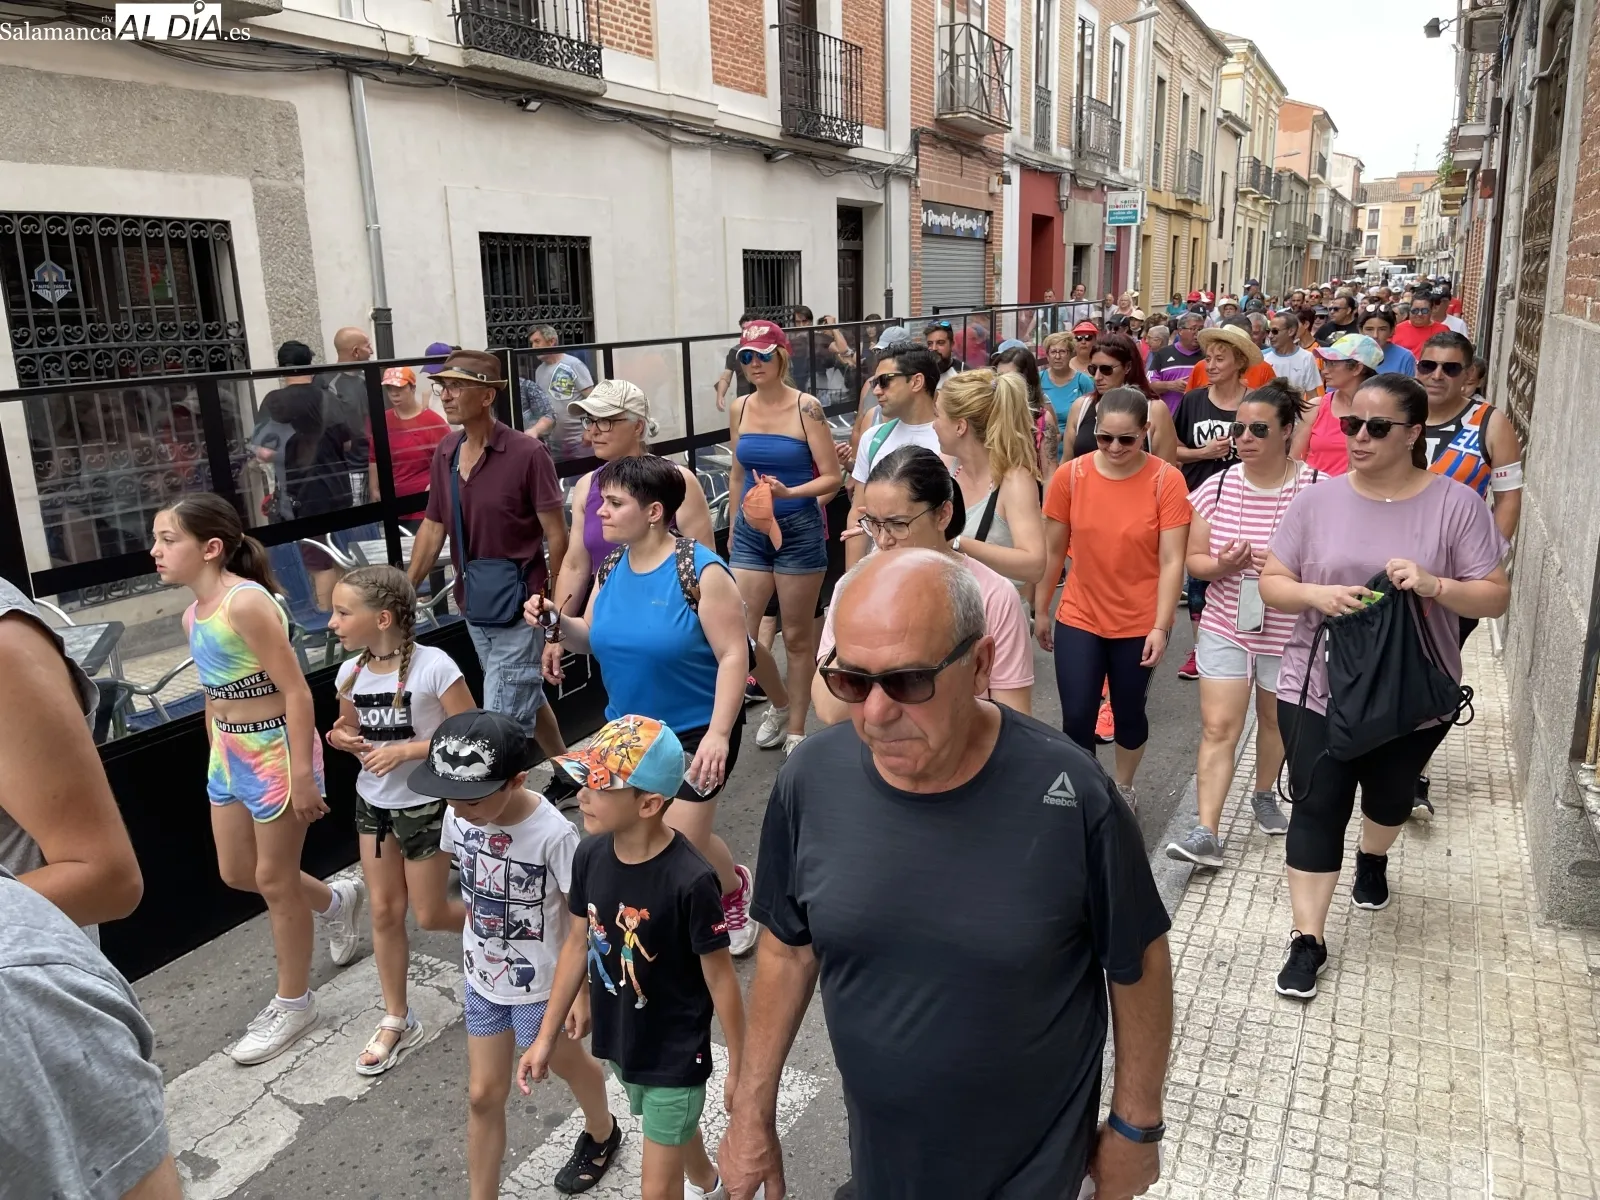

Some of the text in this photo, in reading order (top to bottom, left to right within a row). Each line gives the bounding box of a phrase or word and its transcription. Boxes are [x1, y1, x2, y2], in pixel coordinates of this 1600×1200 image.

[239, 672, 262, 688] LOVE
[250, 683, 274, 697] LOVE
[358, 708, 408, 726] LOVE
[231, 723, 255, 734] LOVE
[1042, 794, 1078, 808] Reebok
